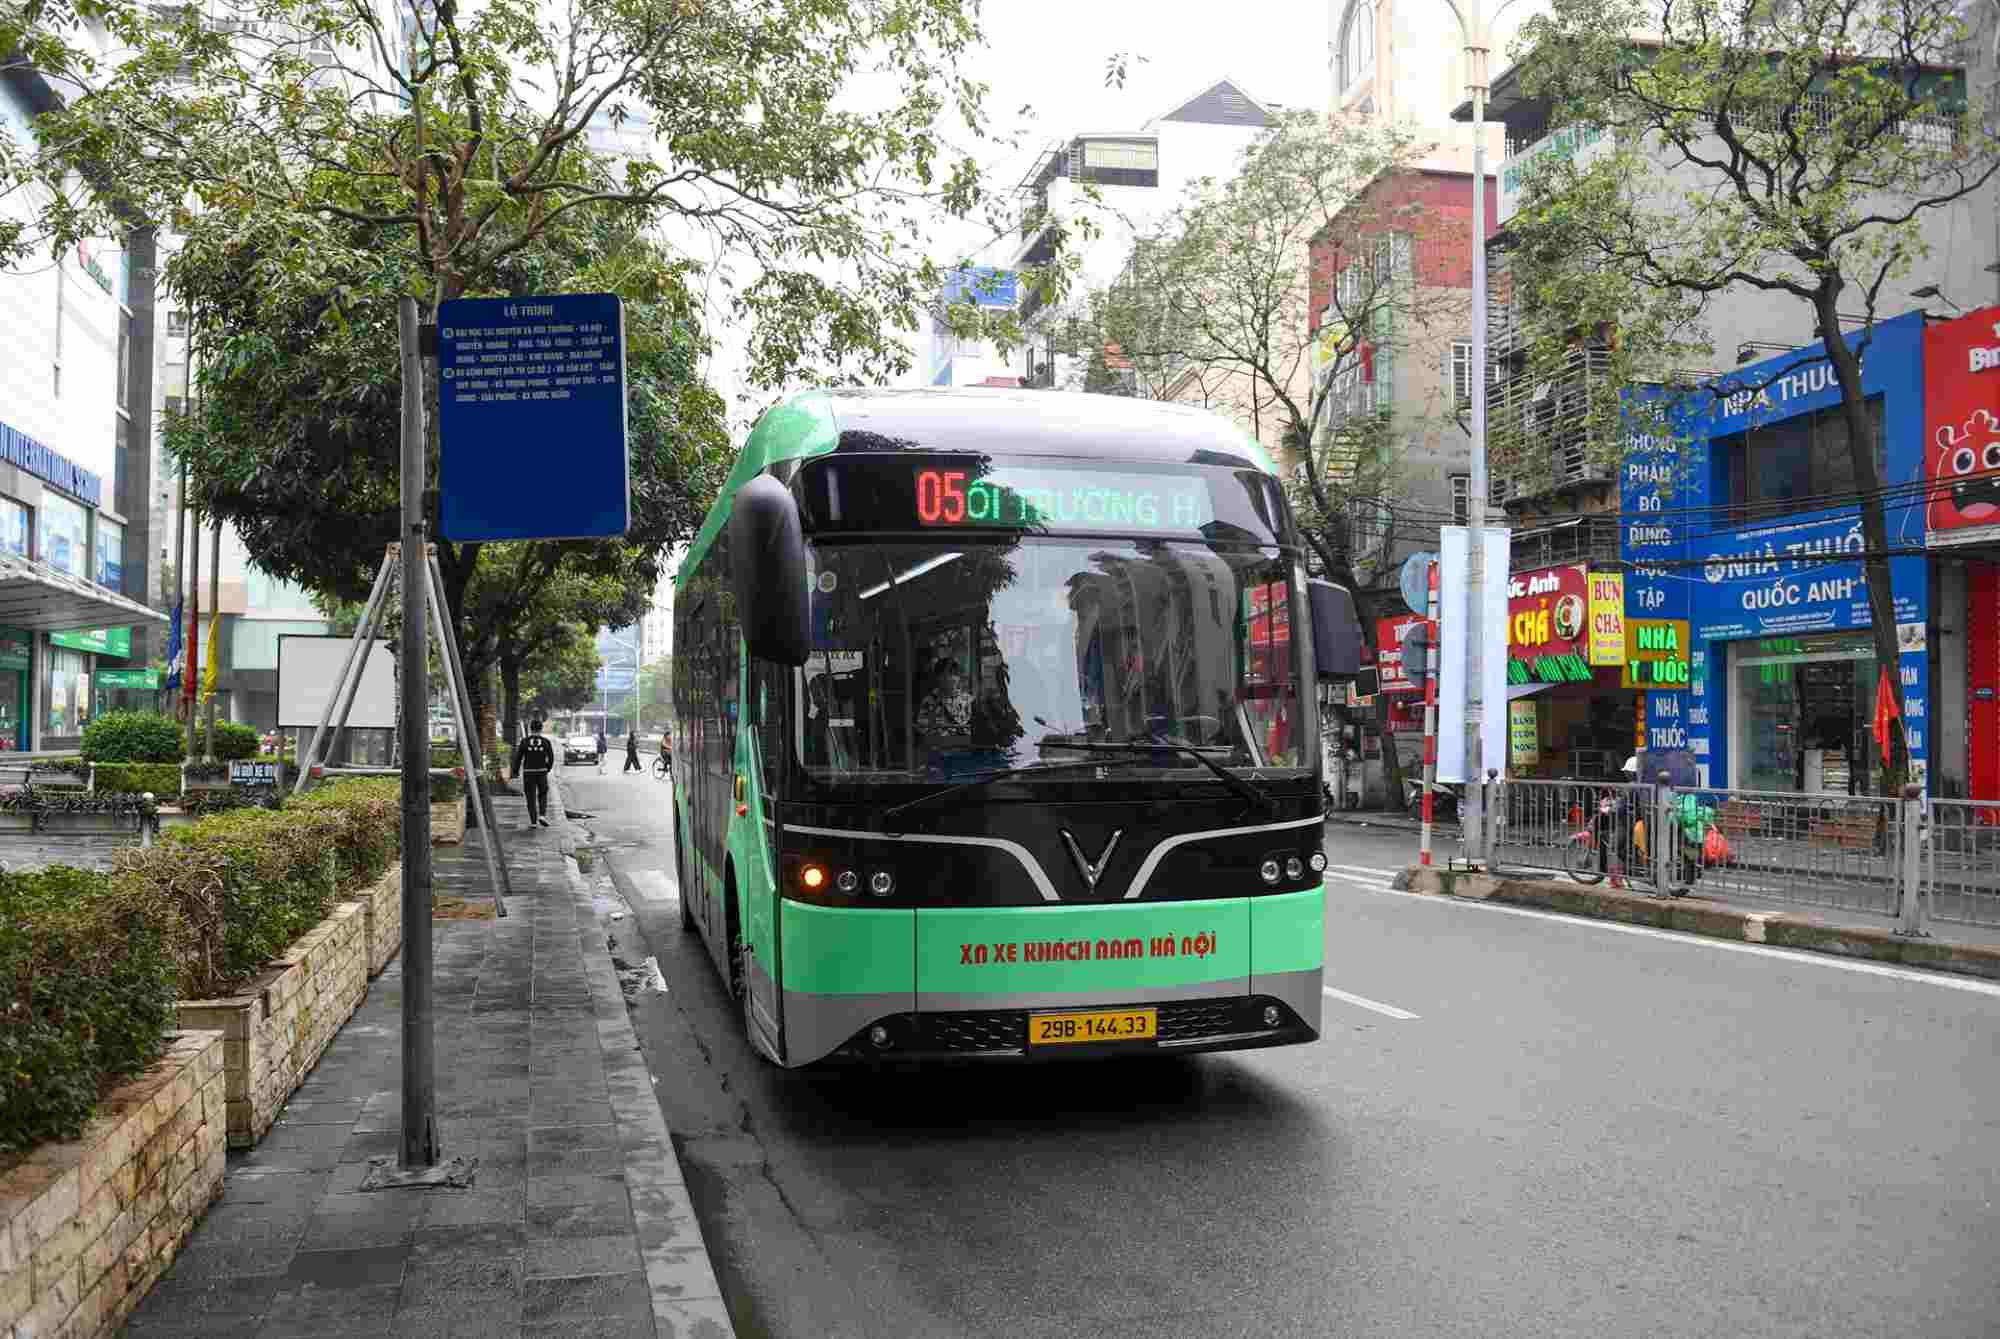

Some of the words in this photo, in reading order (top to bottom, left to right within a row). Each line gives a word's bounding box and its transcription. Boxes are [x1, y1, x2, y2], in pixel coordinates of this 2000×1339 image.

[916, 471, 966, 522] 05
[1785, 520, 1866, 570] THUỐ
[1528, 571, 1560, 596] Anh
[1742, 576, 1801, 610] QUỐC
[1807, 578, 1852, 603] ANH
[1514, 598, 1549, 647] CHẢ
[1639, 623, 1678, 649] NHÀ
[1630, 653, 1689, 683] TUỐC
[1655, 694, 1680, 718] NHÀ
[1651, 719, 1686, 748] THUỐC
[993, 943, 1017, 963] XE
[1023, 938, 1092, 962] KHÁCH
[1149, 931, 1176, 957] HÀ
[1181, 930, 1217, 960] NỘI
[1039, 1015, 1148, 1039] 29B-144.33
